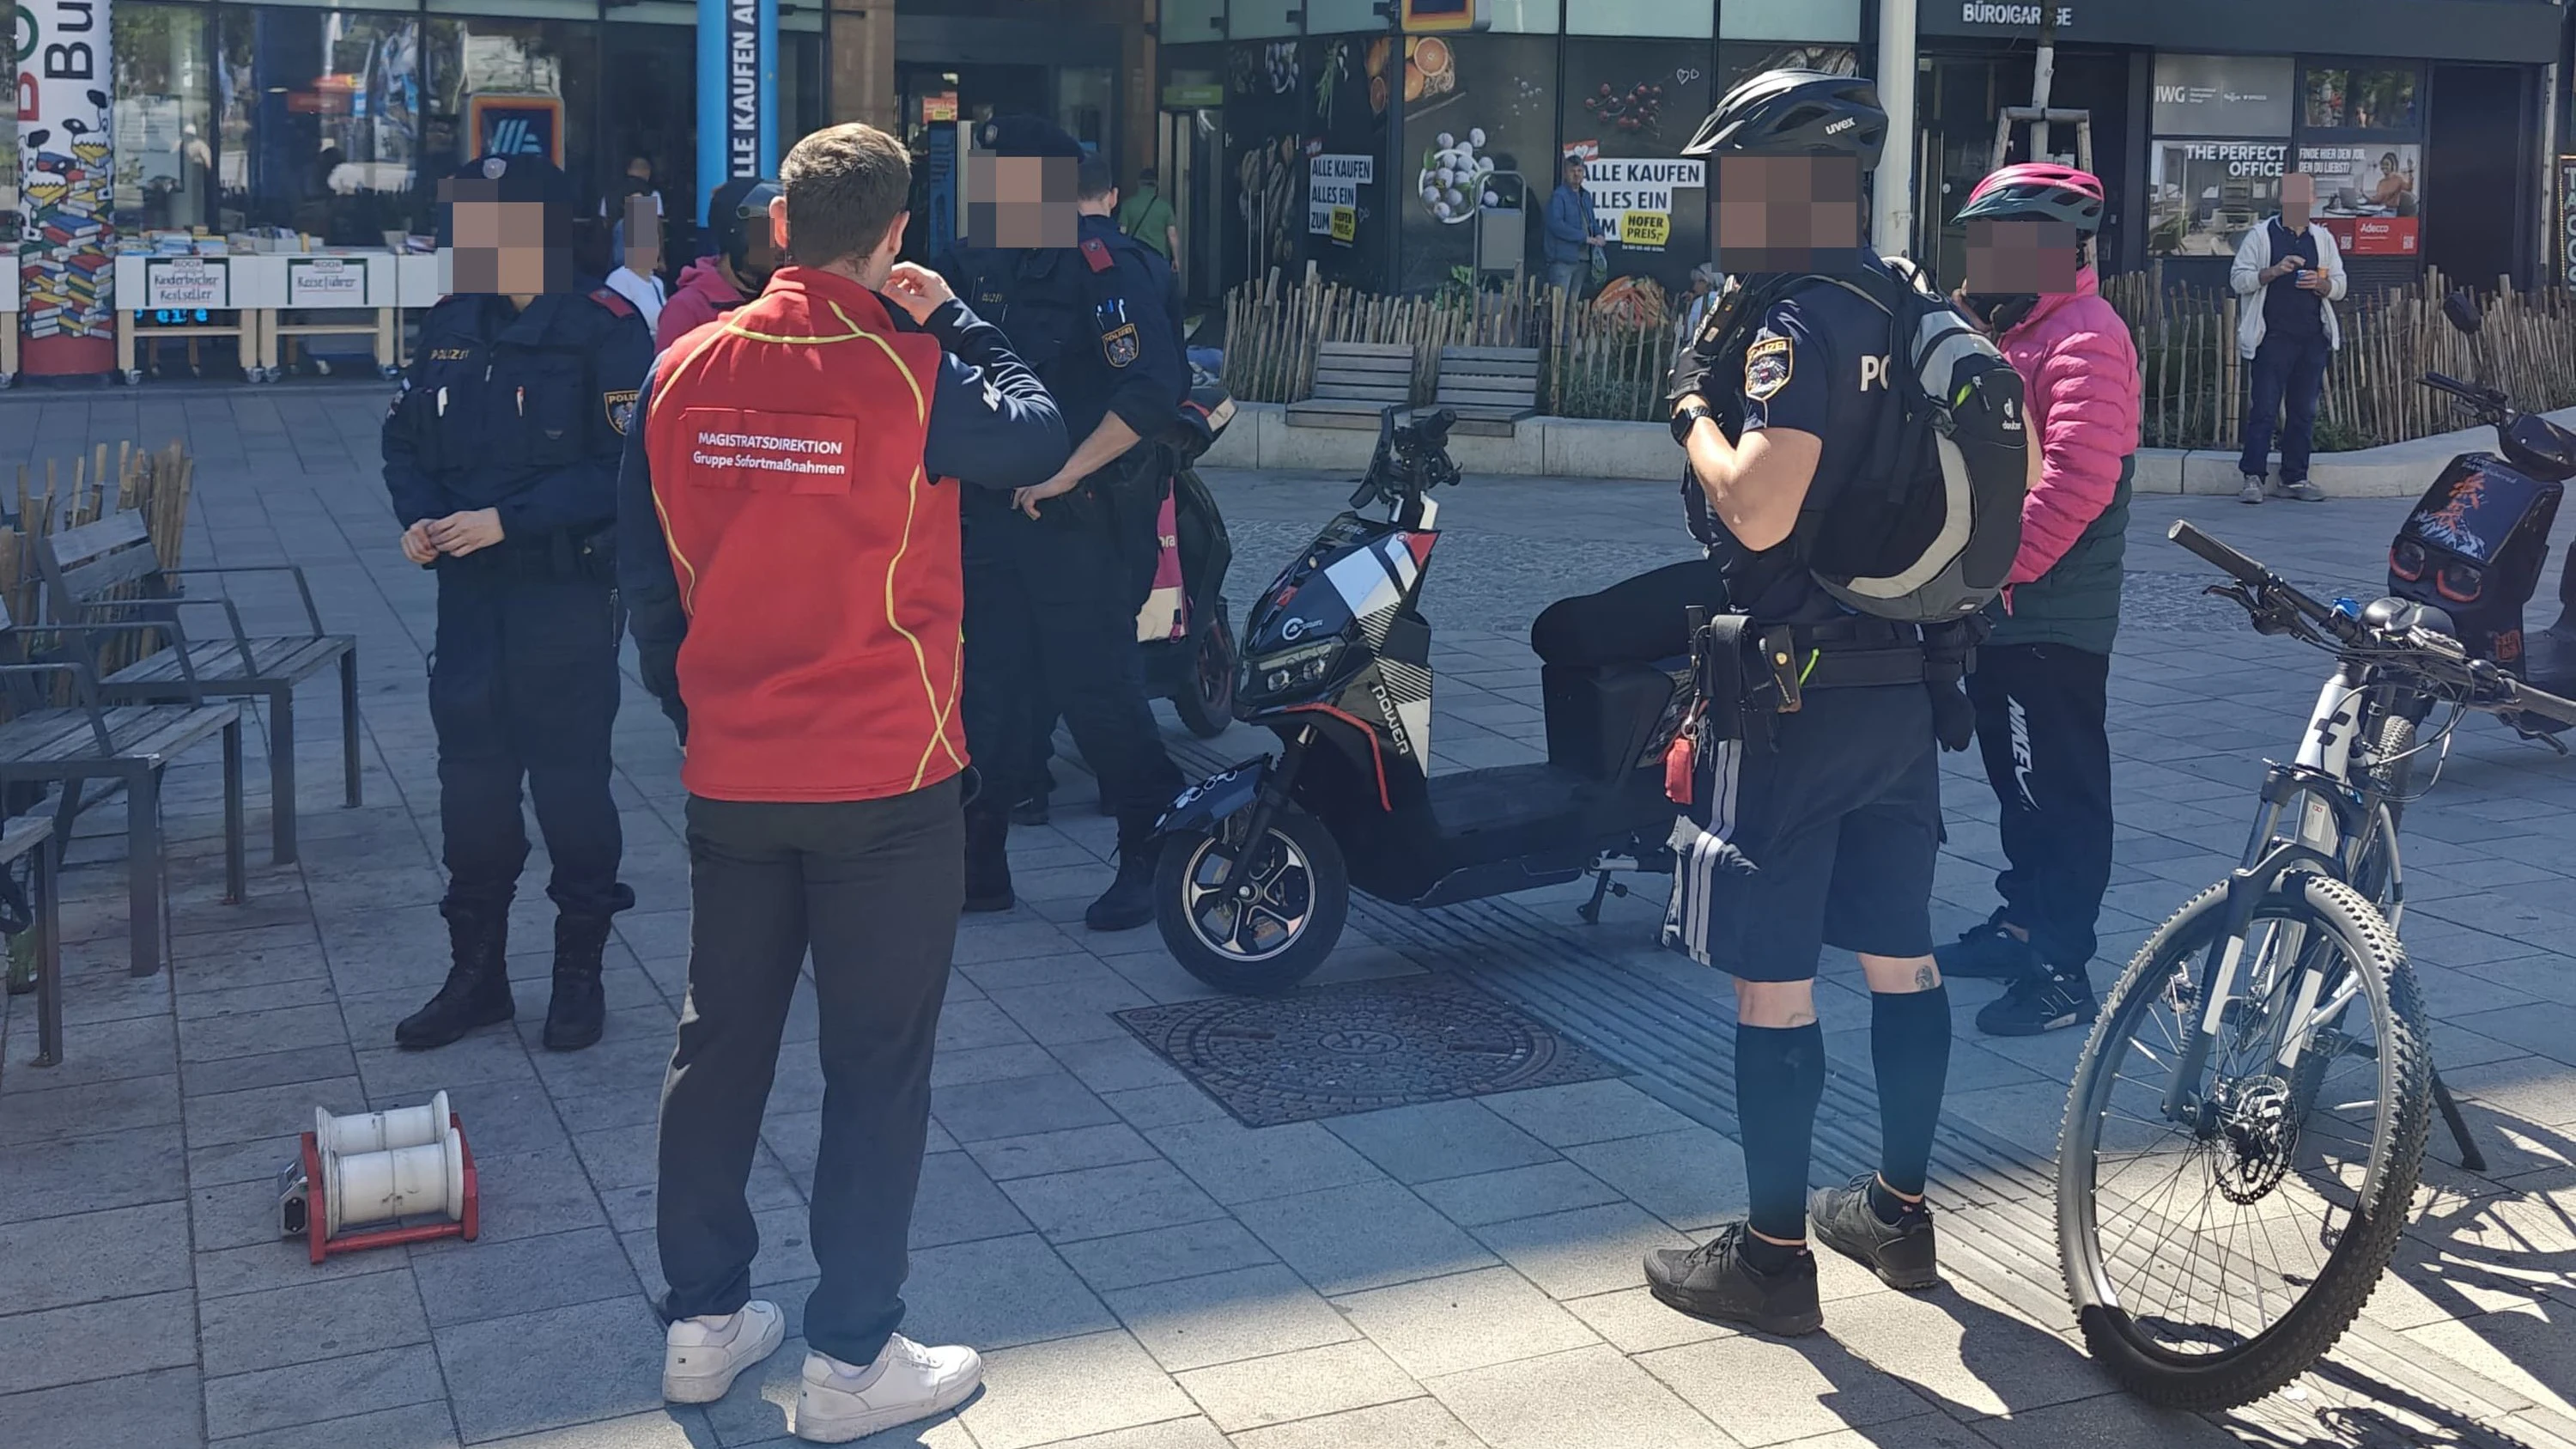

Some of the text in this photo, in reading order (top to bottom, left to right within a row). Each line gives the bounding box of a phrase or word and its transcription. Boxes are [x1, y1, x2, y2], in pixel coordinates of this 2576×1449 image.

[733, 31, 756, 131] KAUFEN
[2154, 85, 2186, 103] IWG
[1825, 116, 1856, 135] uvex
[733, 137, 756, 178] LLE
[2186, 145, 2287, 161] THE PERFECT
[1311, 159, 1371, 180] ALLE KAUFEN
[1627, 164, 1700, 183] KAUFEN
[2228, 161, 2285, 177] OFFICE
[1311, 185, 1355, 206] ALLES EIN
[1593, 191, 1668, 210] LLES EIN
[1310, 210, 1330, 231] ZUM
[1627, 215, 1664, 228] HOFER
[2360, 223, 2390, 234] Adecco
[697, 431, 843, 455] MAGISTRATSDIREKTION
[692, 451, 846, 475] Gruppe Sofortmaßnahmen
[1370, 685, 1410, 756] POWER
[2007, 693, 2032, 770] NIKE
